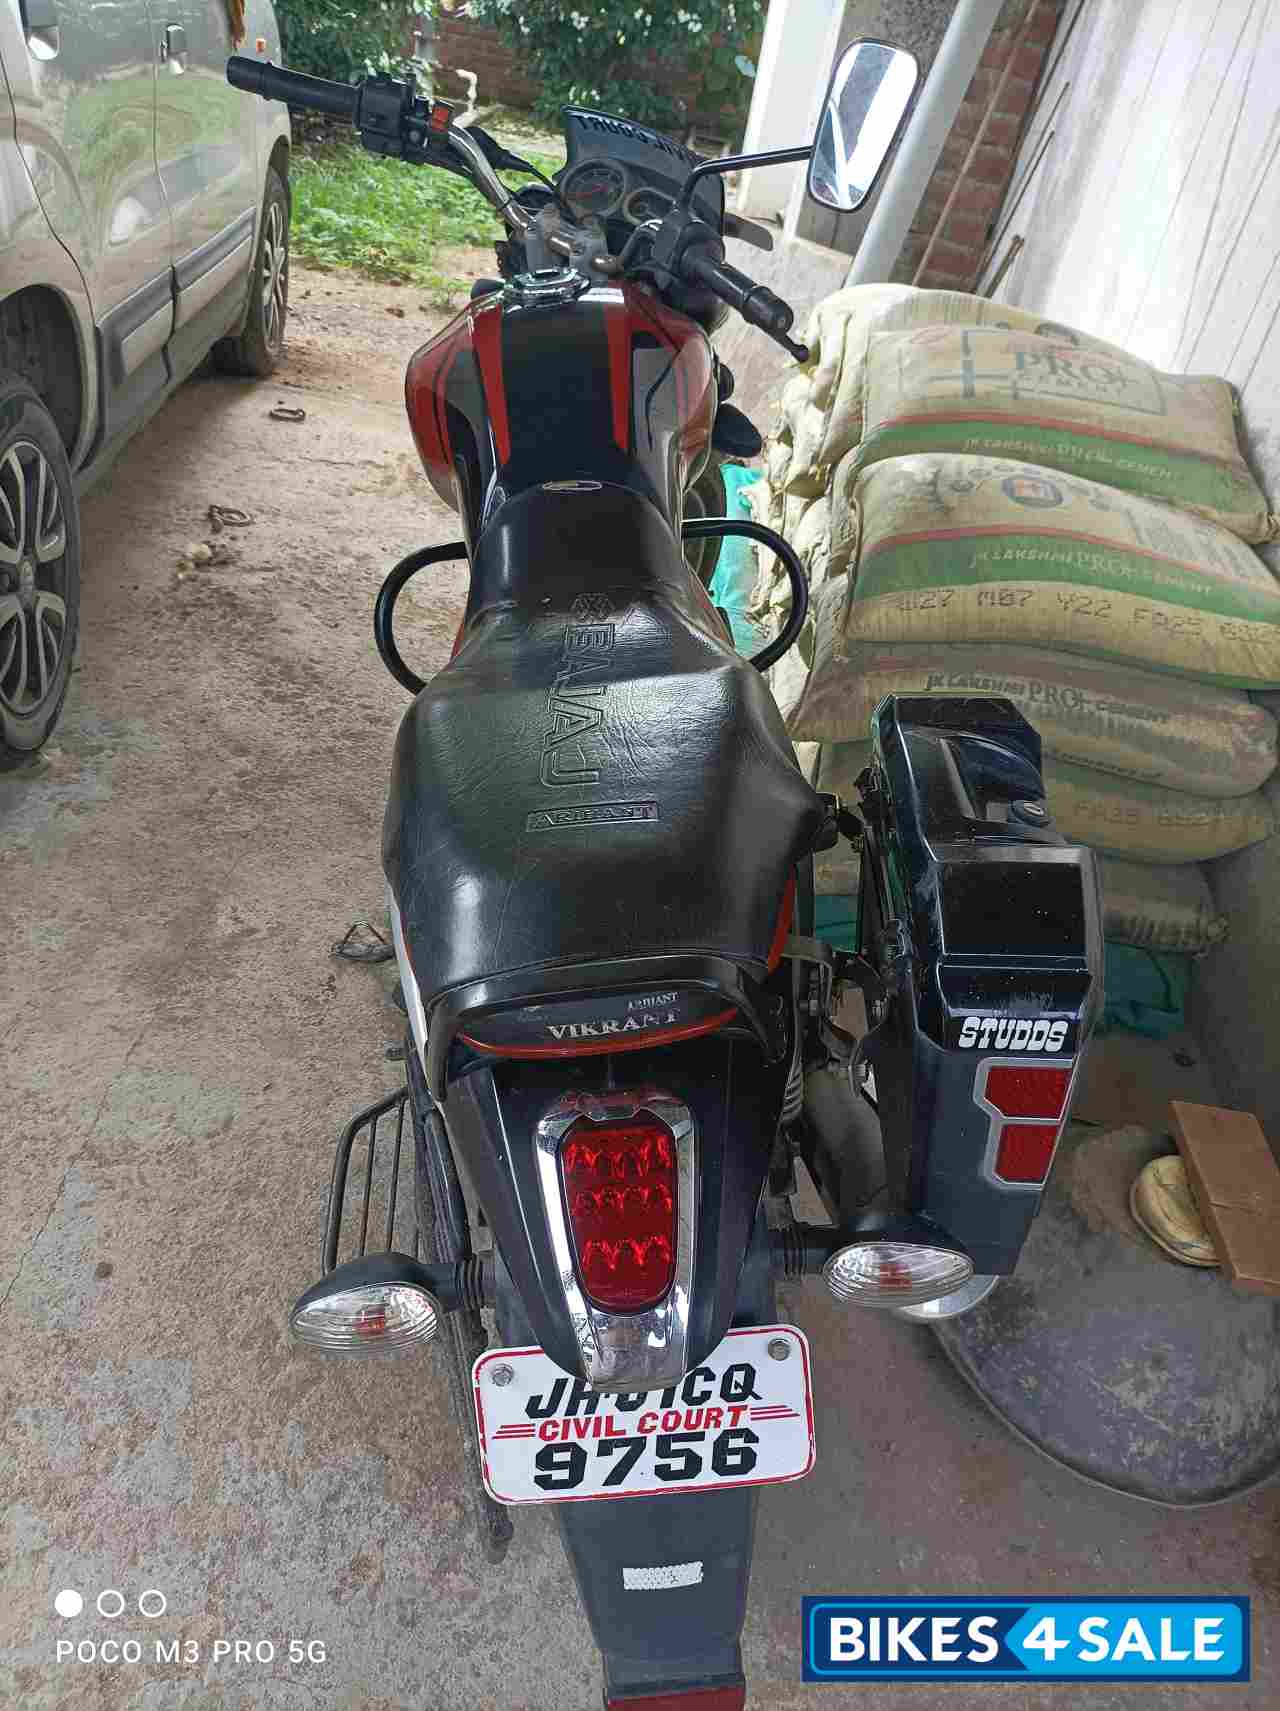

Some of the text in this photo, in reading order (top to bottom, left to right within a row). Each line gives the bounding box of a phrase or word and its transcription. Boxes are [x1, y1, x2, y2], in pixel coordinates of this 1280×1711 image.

[958, 1016, 1069, 1052] STUDDS
[538, 1405, 748, 1441] CIVIL COURT
[533, 1427, 760, 1491] 9756
